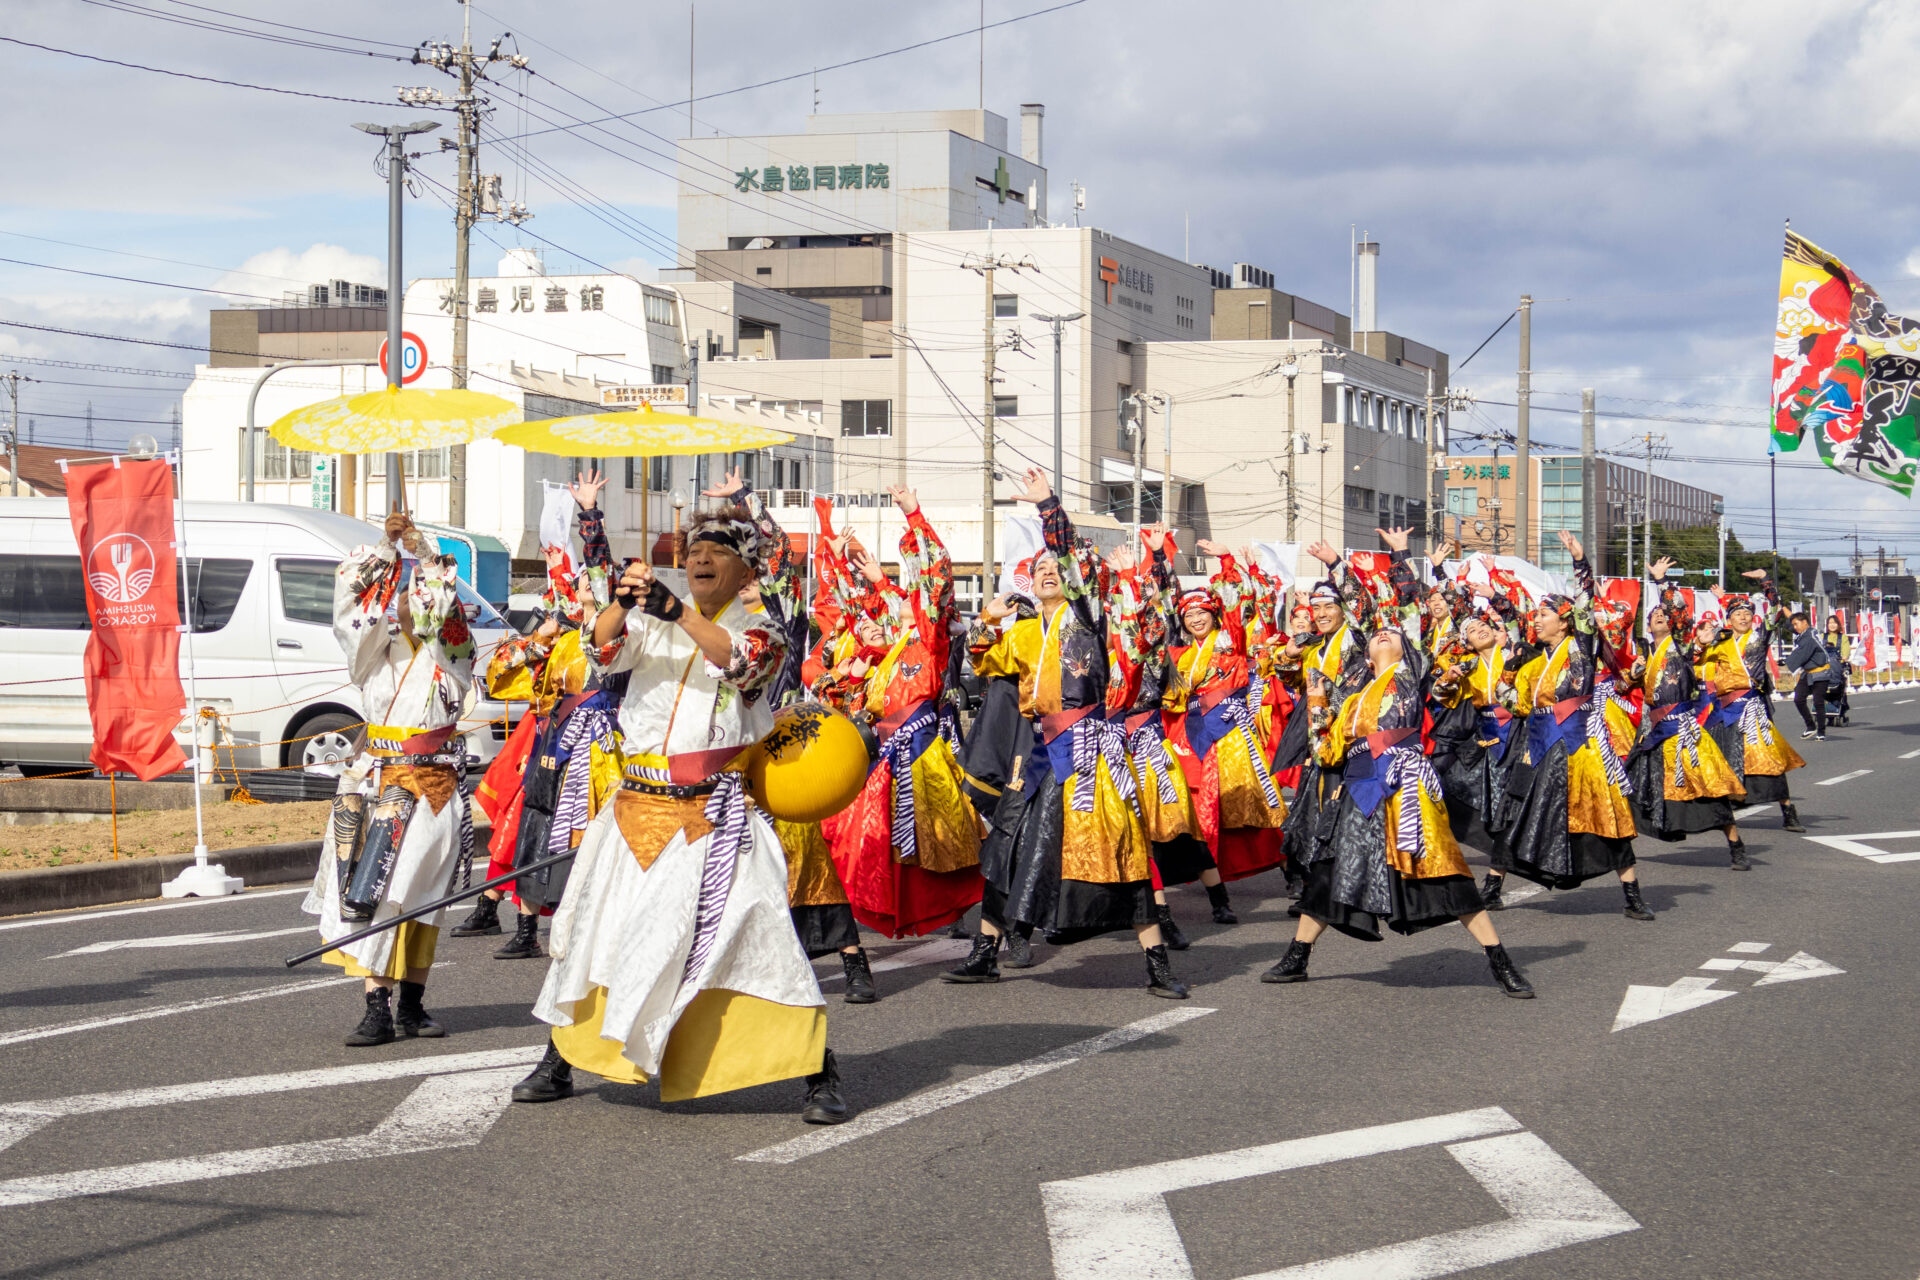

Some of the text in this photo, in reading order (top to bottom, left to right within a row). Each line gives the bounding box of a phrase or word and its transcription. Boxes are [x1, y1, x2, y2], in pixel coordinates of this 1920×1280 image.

[734, 162, 890, 193] 水島協同病院
